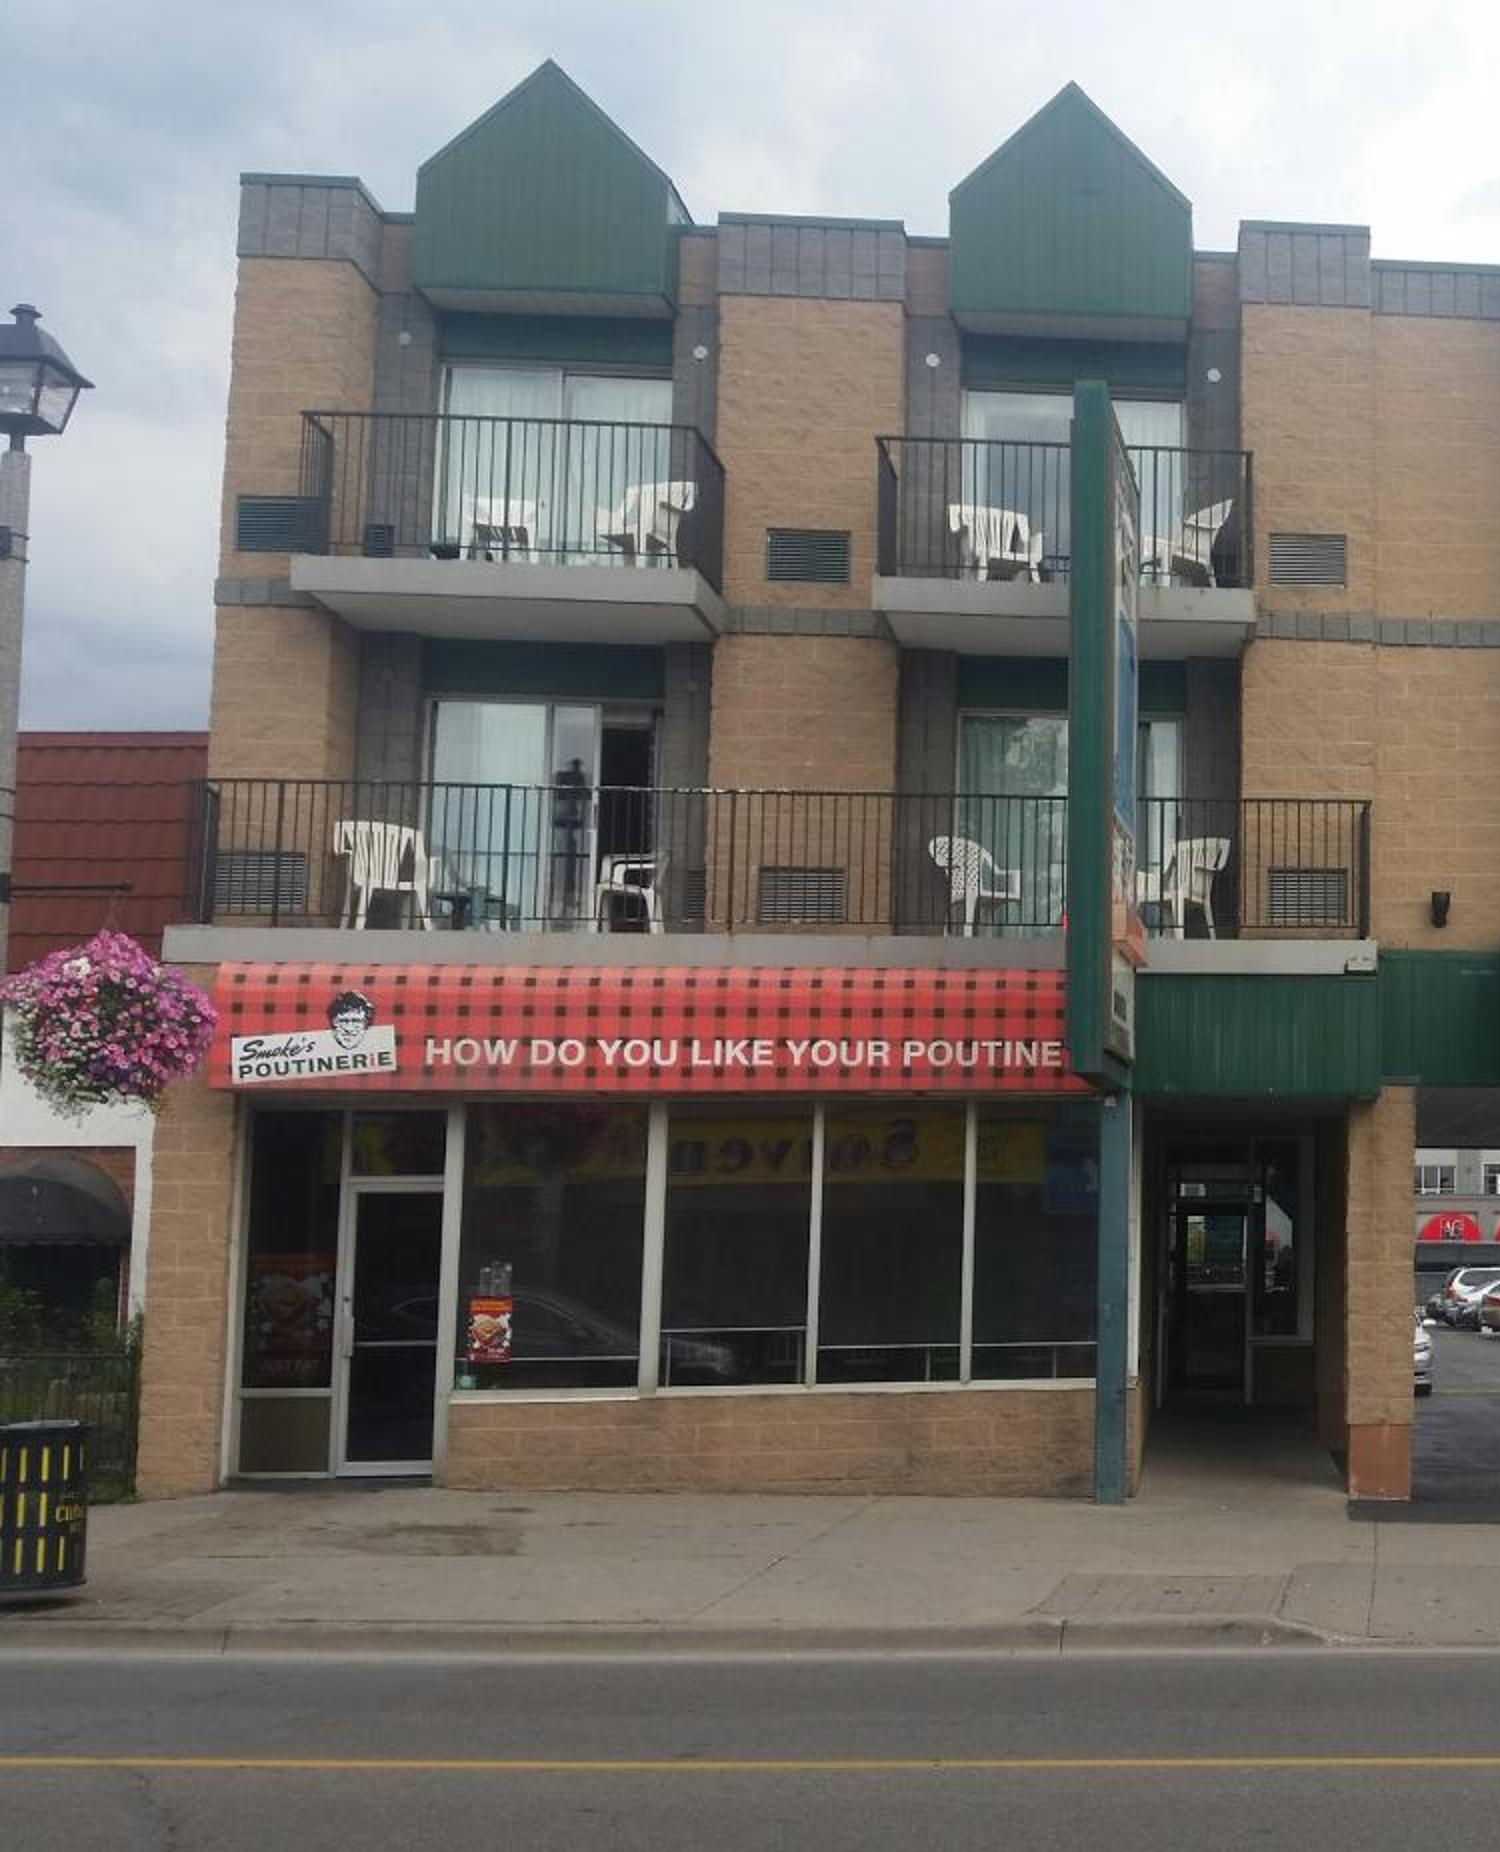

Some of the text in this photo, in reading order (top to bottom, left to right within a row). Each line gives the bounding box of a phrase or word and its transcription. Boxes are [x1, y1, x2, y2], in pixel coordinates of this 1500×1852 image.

[239, 1037, 316, 1062] Smoke's
[425, 1039, 1063, 1067] HOW DO YOU LIKE YOUR POUTINE
